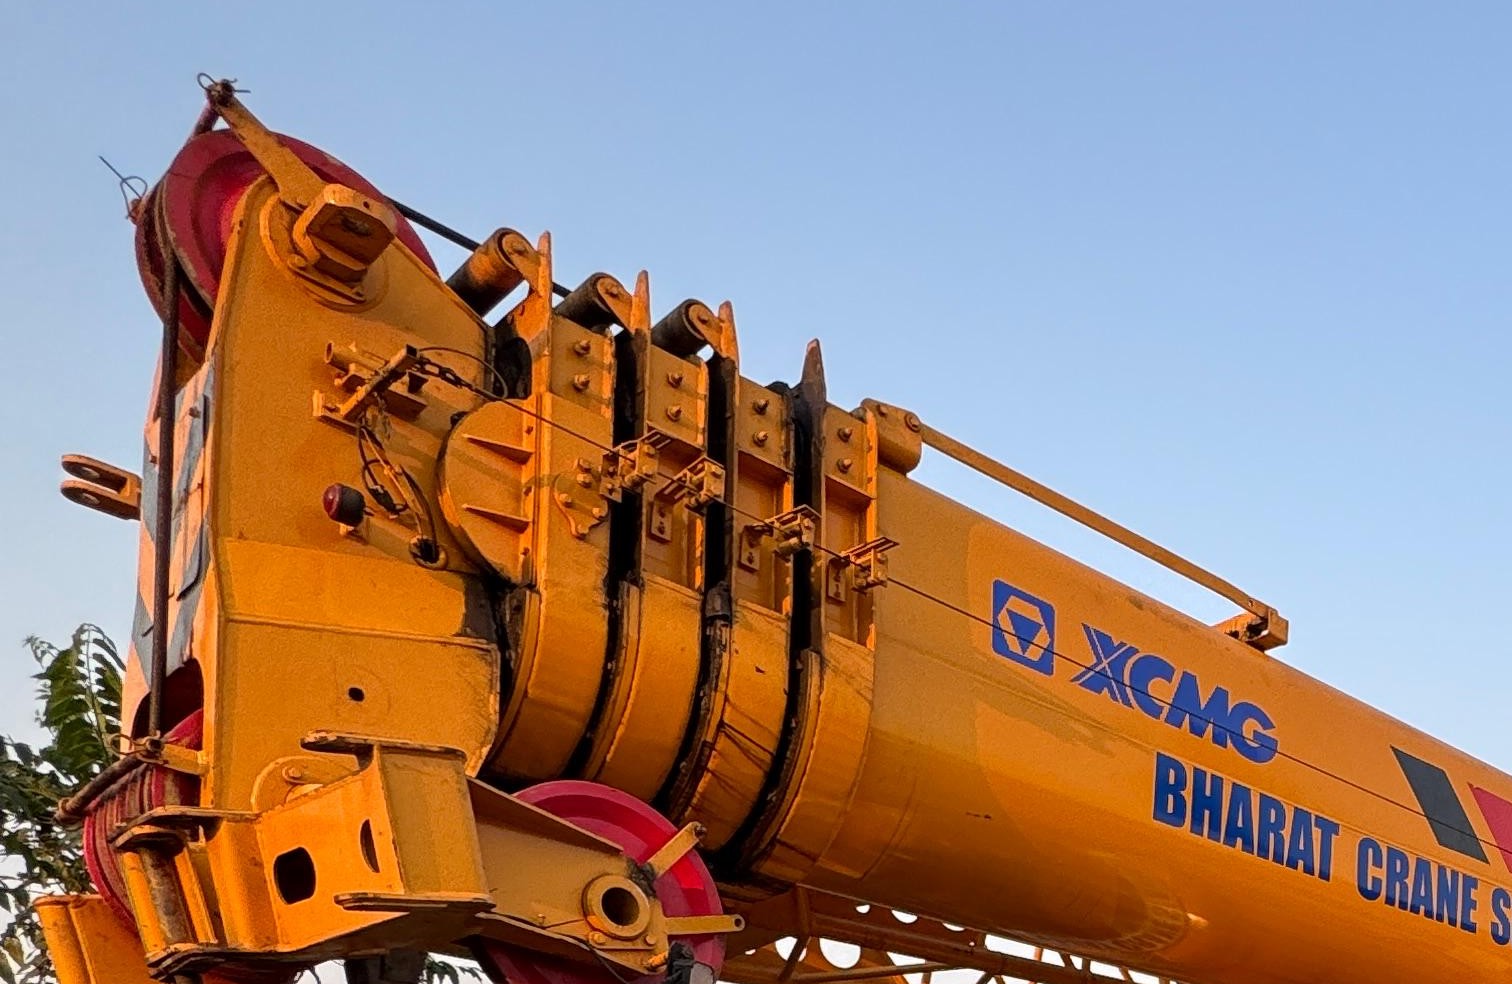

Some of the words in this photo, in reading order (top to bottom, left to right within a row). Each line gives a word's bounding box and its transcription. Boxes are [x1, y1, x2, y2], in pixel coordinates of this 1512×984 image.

[1070, 622, 1278, 764] XCMG
[1153, 751, 1341, 882] BHARAT
[1357, 837, 1479, 934] CRANE
